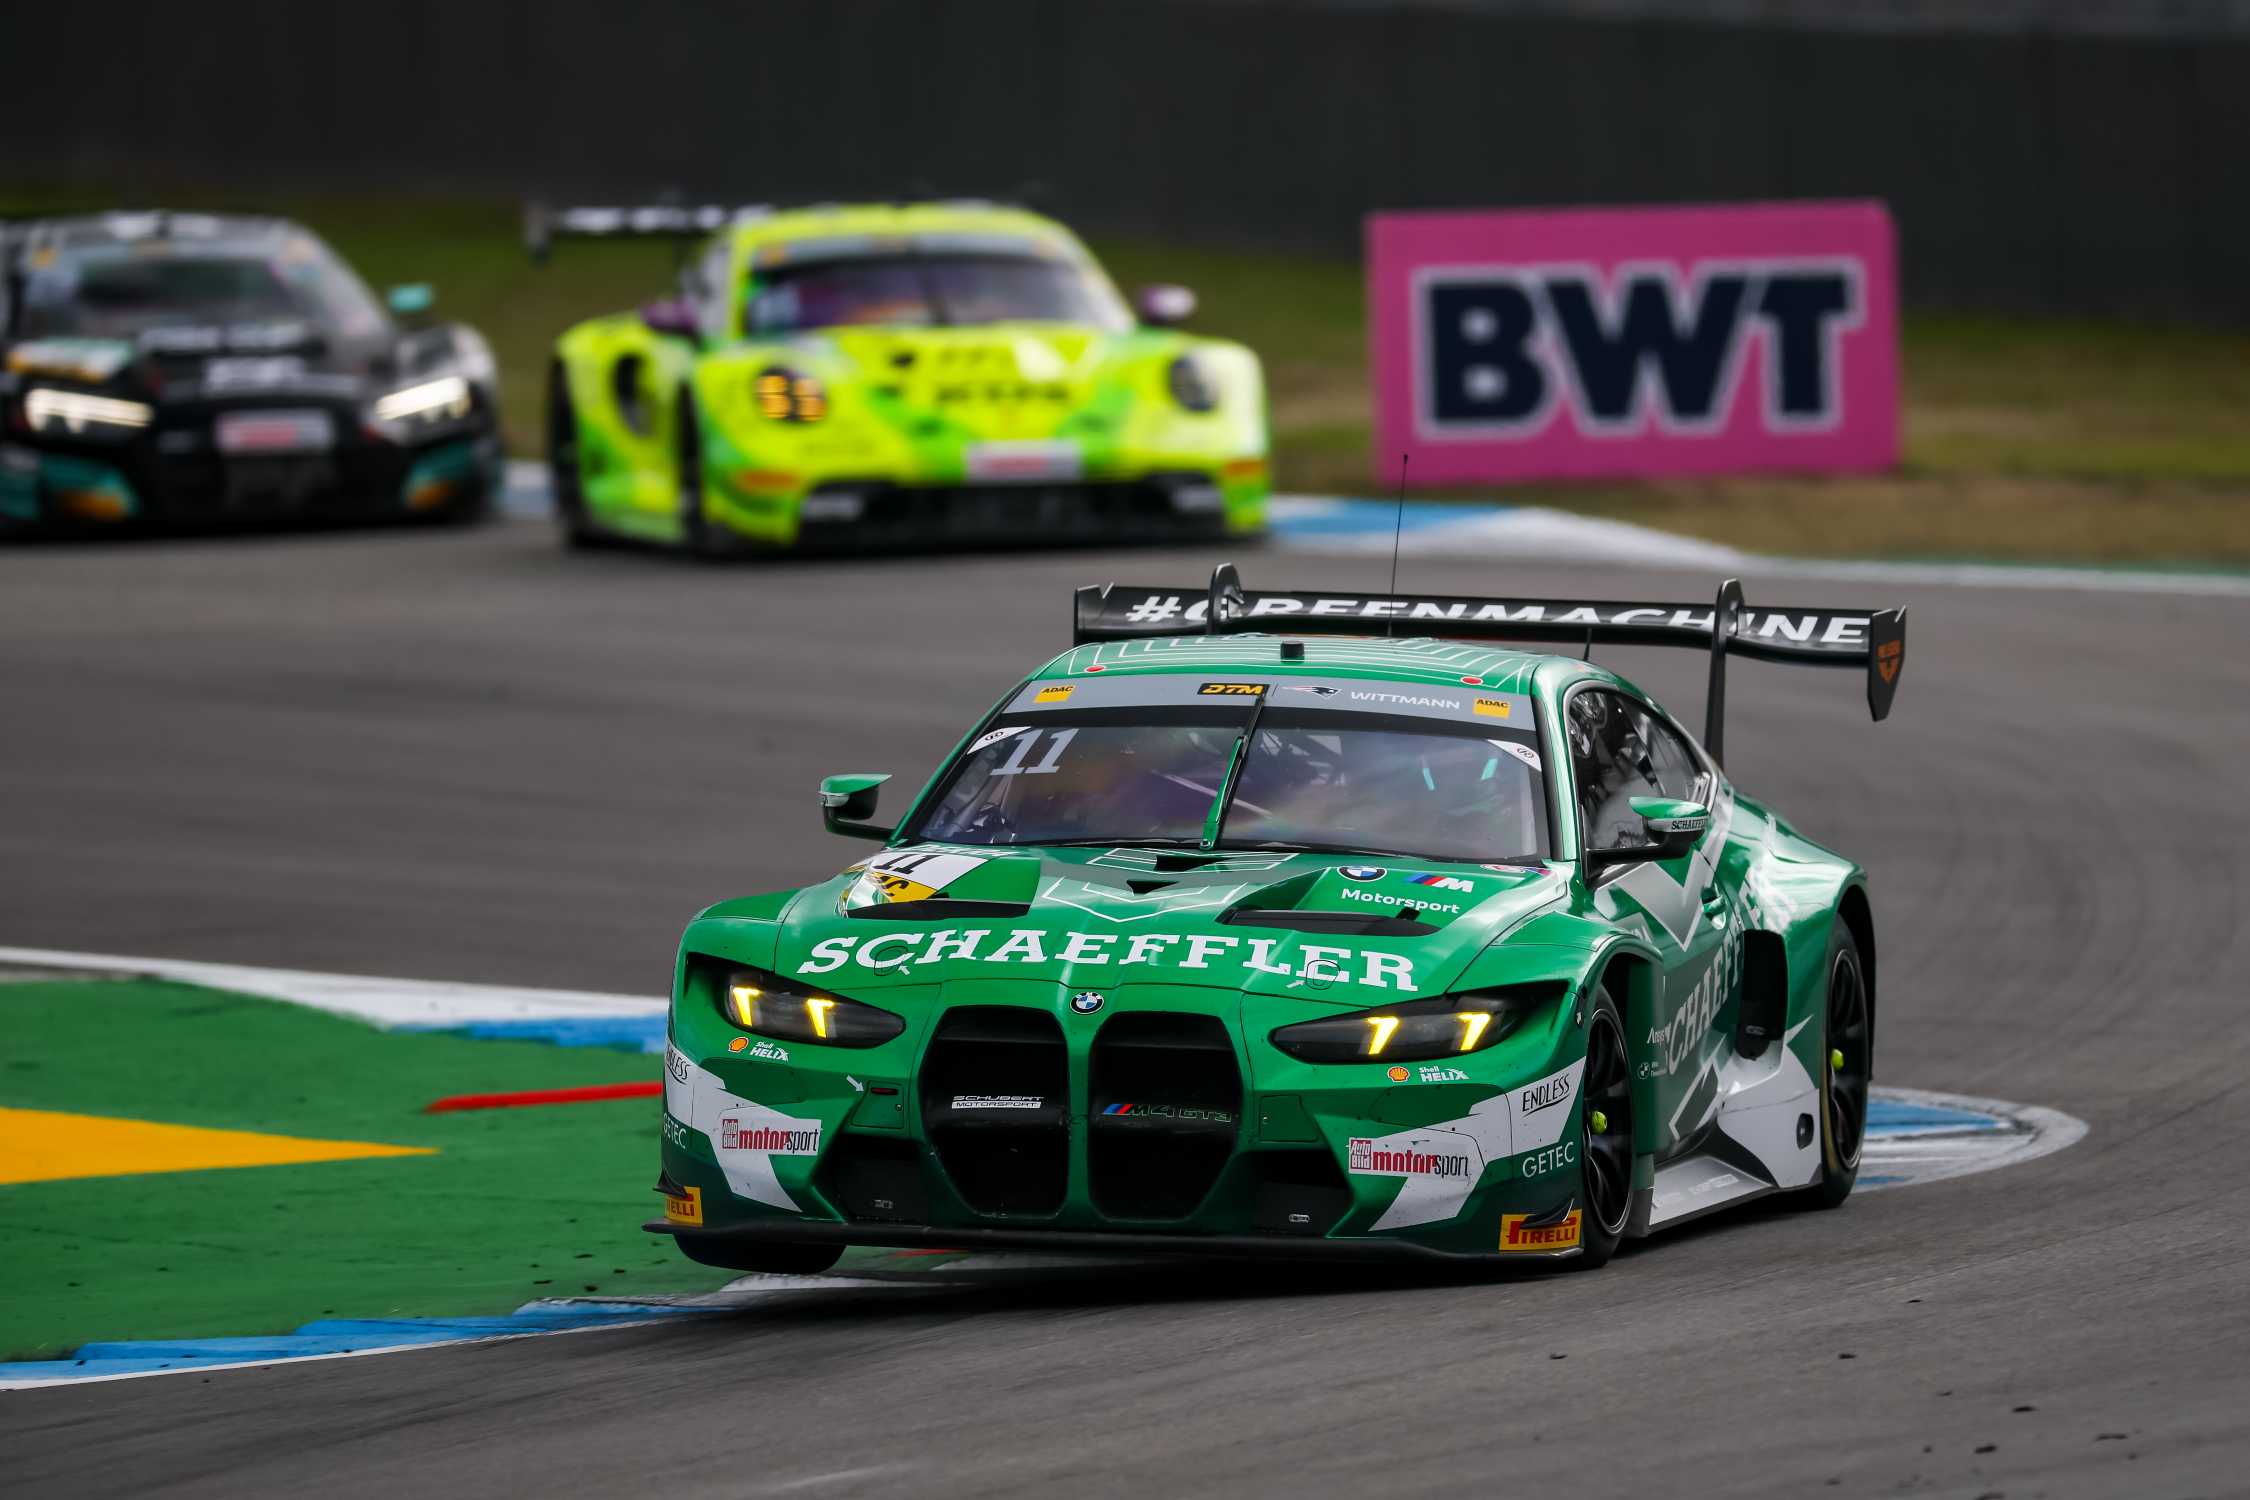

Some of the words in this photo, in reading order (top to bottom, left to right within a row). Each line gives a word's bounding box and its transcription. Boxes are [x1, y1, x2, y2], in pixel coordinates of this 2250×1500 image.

[1425, 267, 1851, 424] BWT
[1041, 685, 1074, 694] ADAC
[1202, 685, 1264, 694] DTM
[1350, 691, 1461, 710] WITTMANN
[1476, 698, 1509, 709] ADAC
[989, 728, 1080, 776] 11
[874, 853, 943, 875] 11
[1341, 888, 1461, 914] Motorsport
[798, 928, 1420, 993] SCHAEFFLER
[749, 1047, 789, 1062] HELIX
[755, 1041, 774, 1050] Shell
[1418, 1066, 1440, 1074] Shell
[1421, 1070, 1470, 1083] HELIX
[1521, 1074, 1570, 1112] ENDLESS
[723, 1120, 739, 1134] Auto
[739, 1127, 819, 1154] motorsport
[1351, 1140, 1371, 1155] Auto
[1351, 1154, 1371, 1170] Bild
[1372, 1149, 1469, 1179] motorsport
[1522, 1141, 1575, 1178] GETEC
[1508, 1217, 1577, 1244] PIRELLI
